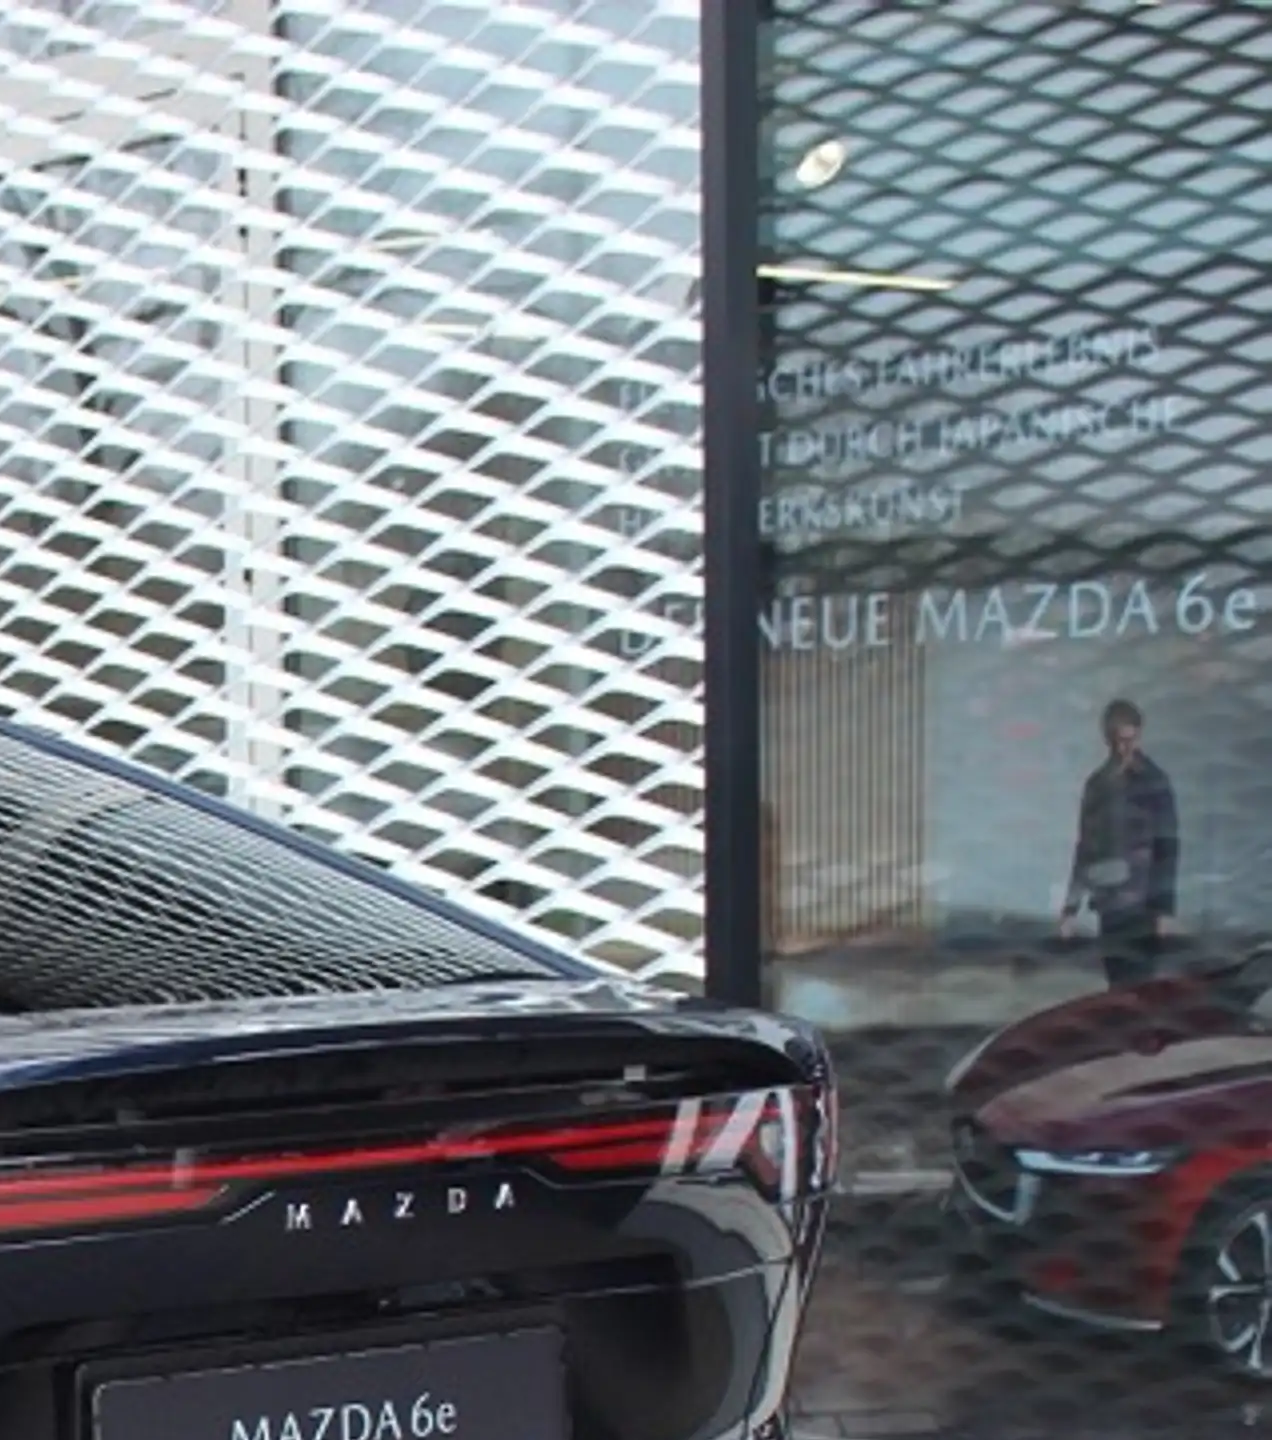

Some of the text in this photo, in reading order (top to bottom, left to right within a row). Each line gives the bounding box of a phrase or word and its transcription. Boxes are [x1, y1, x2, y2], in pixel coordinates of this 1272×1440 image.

[787, 419, 923, 467] DURCH
[913, 579, 1158, 645] MAZDA
[285, 1182, 516, 1231] MAZDA
